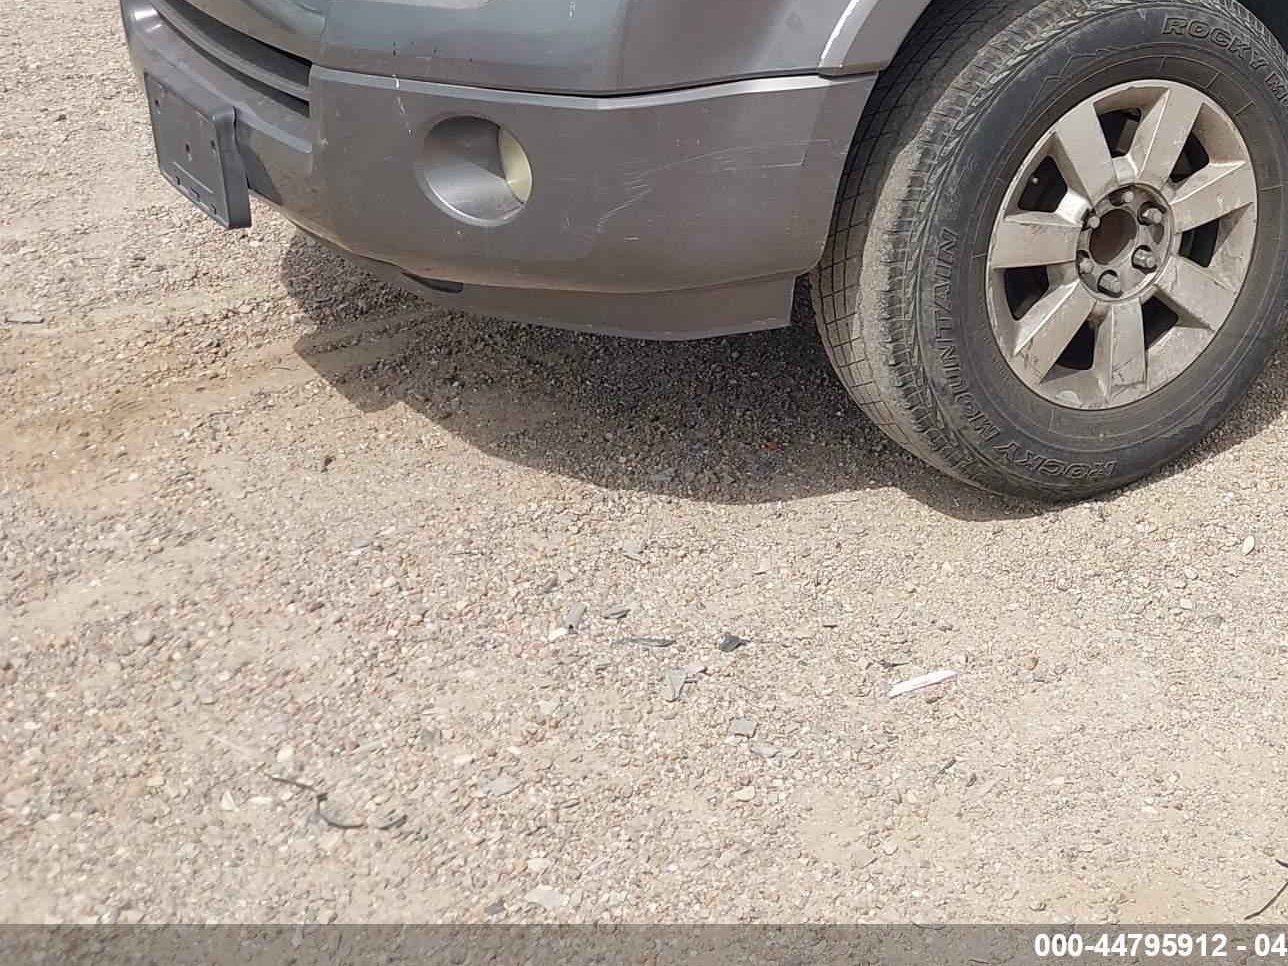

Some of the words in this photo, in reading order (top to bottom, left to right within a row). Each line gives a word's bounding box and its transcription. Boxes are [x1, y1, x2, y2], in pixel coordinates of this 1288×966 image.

[1163, 16, 1268, 71] ROCKY
[933, 227, 1001, 443] MOUNTAIN
[993, 441, 1118, 480] ROCKY
